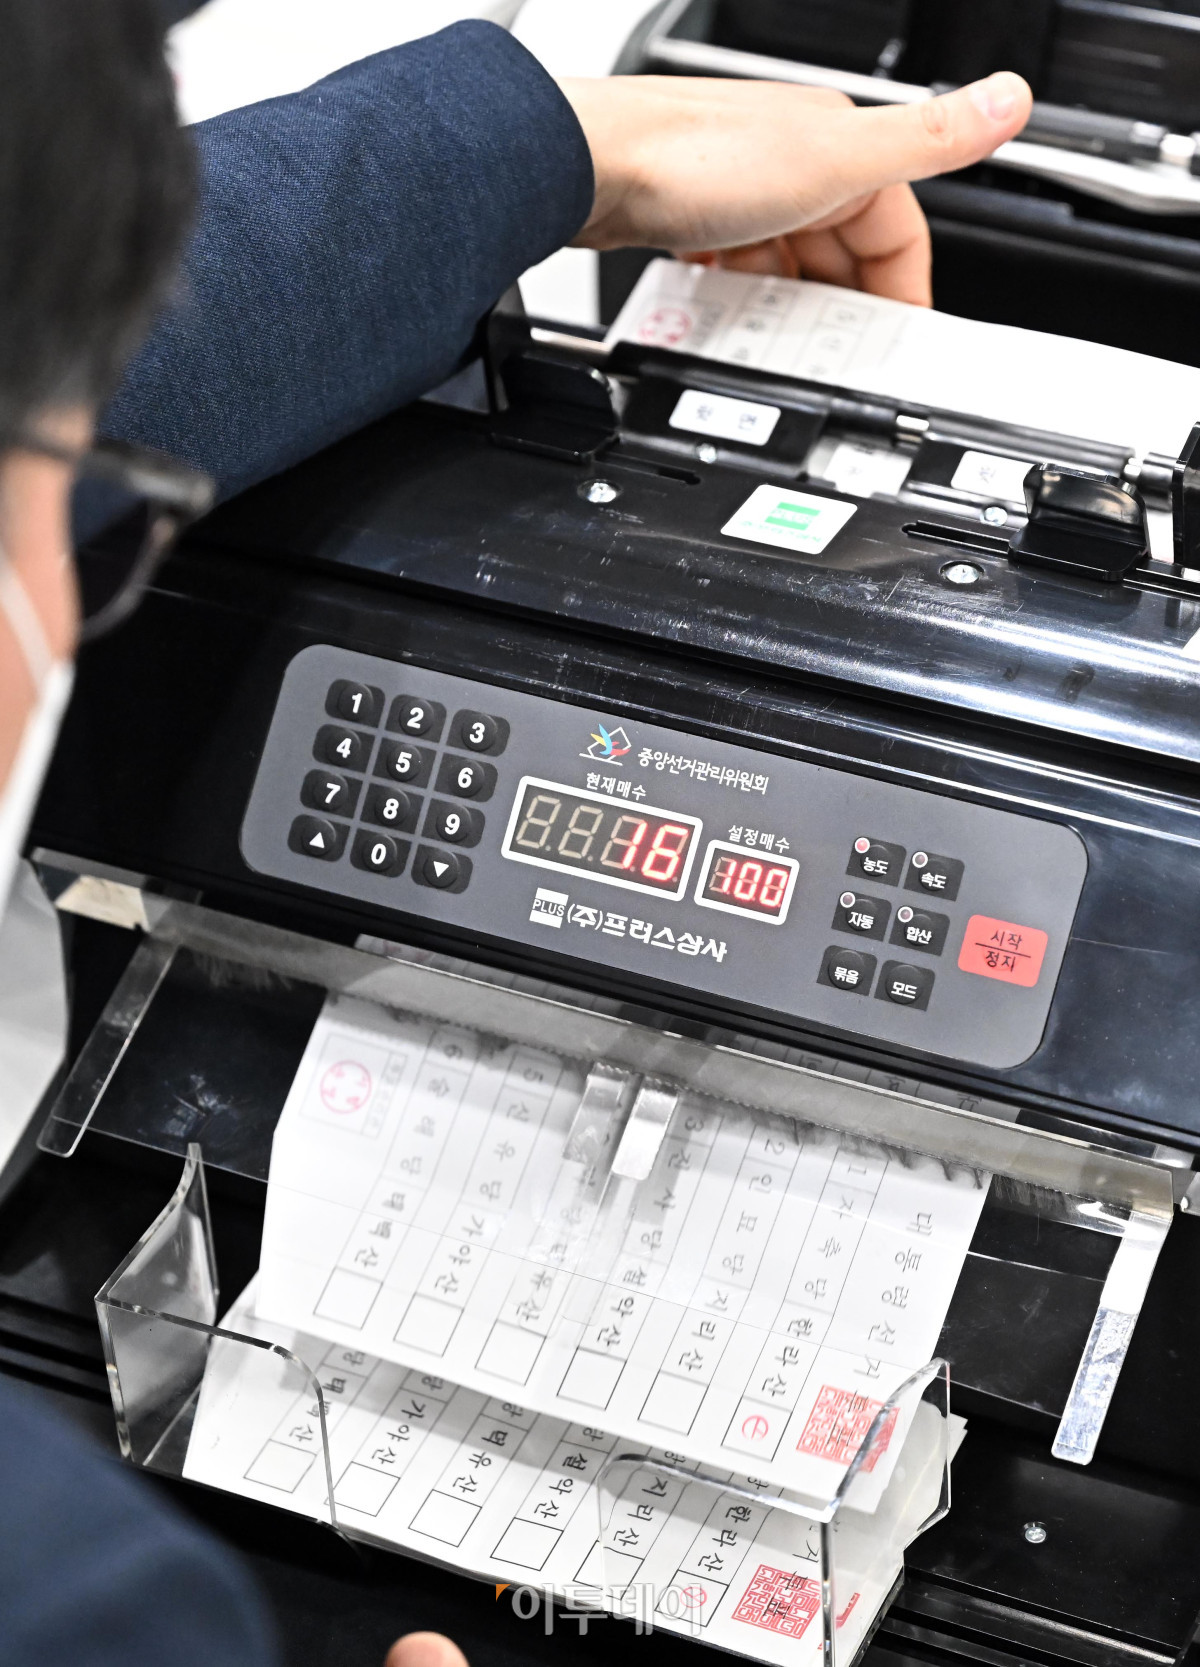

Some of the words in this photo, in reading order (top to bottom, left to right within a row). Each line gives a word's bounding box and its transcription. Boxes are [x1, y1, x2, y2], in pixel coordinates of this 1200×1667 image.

[351, 692, 363, 713] 1
[407, 707, 424, 728] 2
[469, 722, 485, 744] 3
[336, 737, 352, 758] 4
[395, 751, 413, 773] 5
[637, 746, 769, 795] 중앙선거관리위원회
[457, 767, 474, 788] 6
[586, 772, 647, 801] 현재매수
[326, 783, 341, 803] 7
[382, 798, 399, 819] 8
[444, 814, 461, 835] 9
[728, 825, 790, 853] 설정매수
[370, 843, 386, 864] 0
[863, 857, 888, 874] 농도
[722, 857, 789, 907] 100
[921, 872, 946, 889] 속도
[532, 898, 565, 917] PLUS
[566, 902, 728, 963] (주)프러스상사
[848, 911, 874, 930] 자동
[906, 926, 932, 944] 합산
[990, 930, 1022, 949] 시작
[985, 951, 1017, 972] 정지
[834, 967, 859, 984] 묶음
[891, 981, 917, 999] 모드
[763, 1138, 785, 1154] 2
[434, 1213, 484, 1295] 가야산
[597, 1269, 648, 1349] 설악산
[678, 1289, 728, 1373] 지리산
[761, 1318, 813, 1397] 한라산
[371, 1398, 426, 1465] 가야산
[452, 1430, 508, 1494] 덕유산
[533, 1451, 589, 1520] 설악산
[613, 1477, 668, 1548] 지리산
[697, 1505, 750, 1574] 한라산
